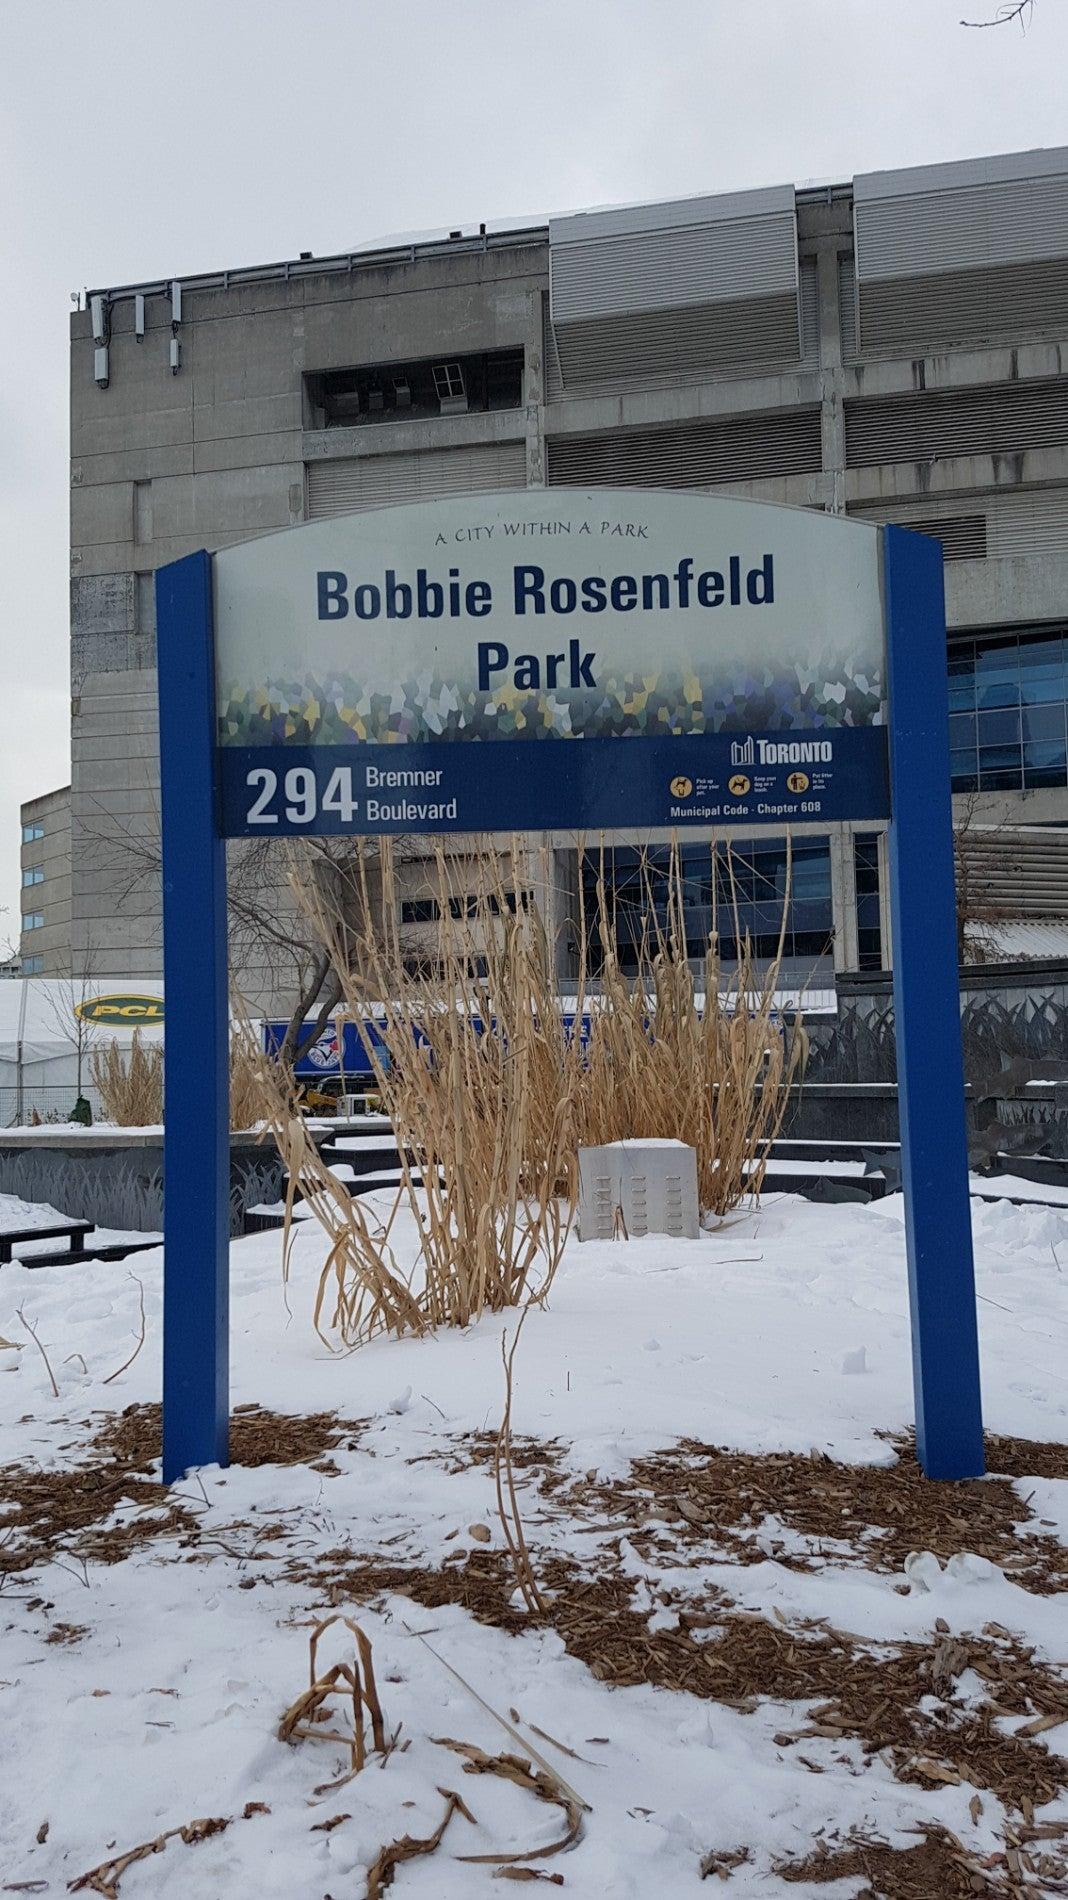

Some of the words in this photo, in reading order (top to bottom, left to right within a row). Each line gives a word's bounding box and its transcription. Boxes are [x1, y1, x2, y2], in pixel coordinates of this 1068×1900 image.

[435, 532, 448, 546] A
[455, 525, 494, 542] CITY
[503, 521, 571, 536] WITHIN
[579, 521, 592, 535] A
[600, 521, 649, 539] PARK
[316, 568, 493, 620] Bobbie
[513, 554, 775, 615] Rosenfeld
[477, 638, 598, 691] Park
[756, 739, 833, 765] TORONTO
[365, 766, 443, 788] Bremner
[246, 766, 359, 824] 294
[366, 798, 458, 821] Boulevard
[670, 805, 721, 818] Municipal
[723, 804, 749, 816] Code
[757, 803, 799, 815] Chapter
[801, 801, 821, 813] 608
[92, 1005, 165, 1017] PCL
